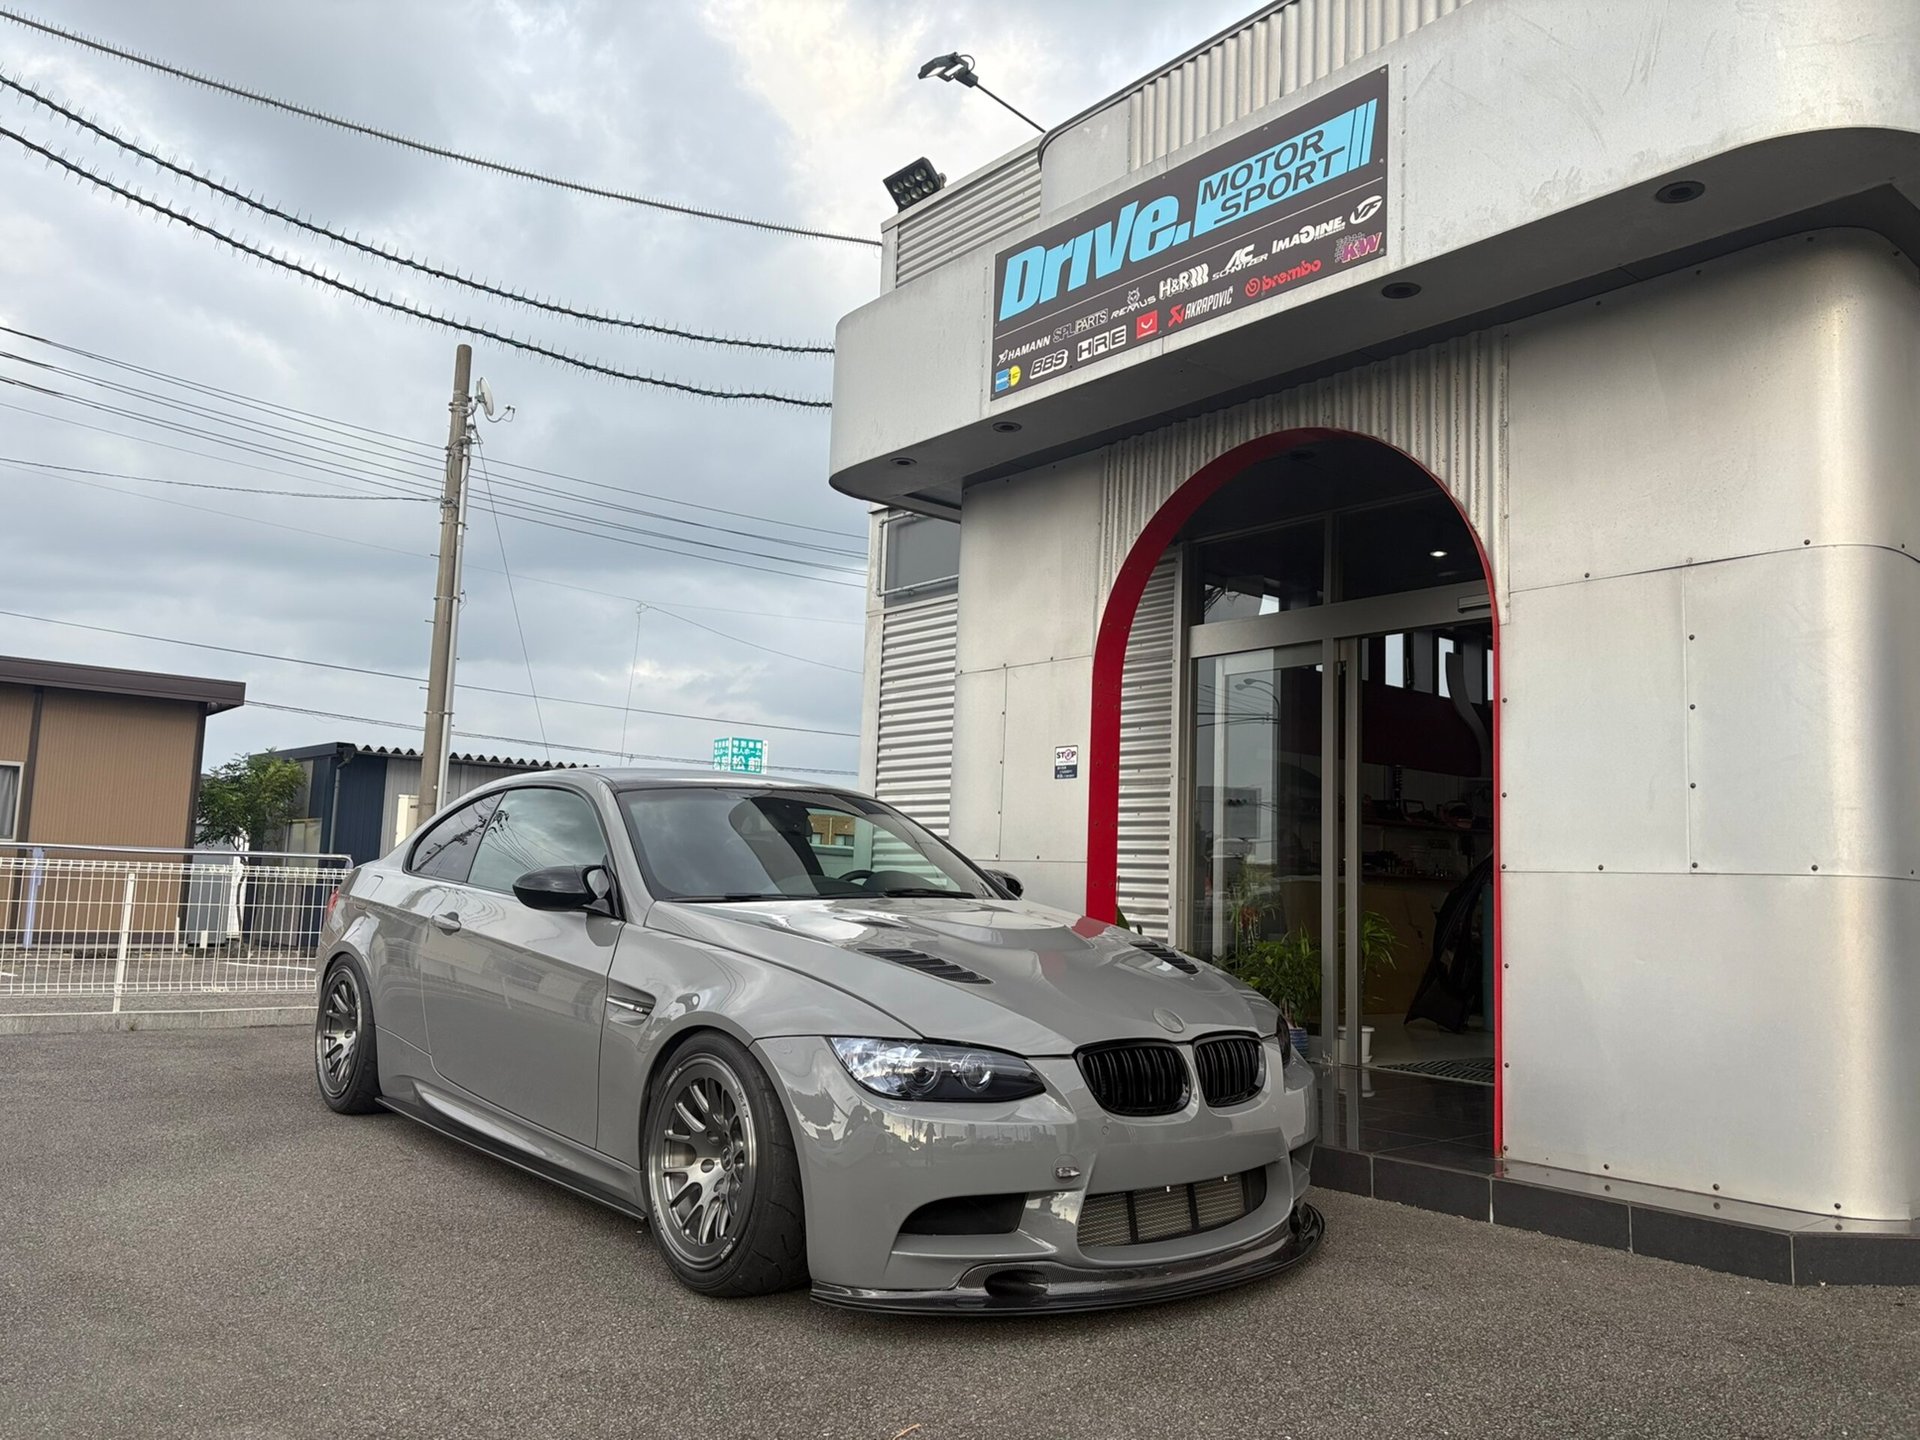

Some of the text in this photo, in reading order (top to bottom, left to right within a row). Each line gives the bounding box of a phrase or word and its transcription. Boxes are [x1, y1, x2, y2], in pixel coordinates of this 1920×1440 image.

[1201, 129, 1325, 205] MOTOR
[1214, 145, 1346, 225] SPORT
[1224, 243, 1256, 272] AC
[1341, 231, 1383, 263] KW
[1212, 253, 1269, 281] SCHNITZER
[1262, 259, 1323, 292] brembo
[1110, 295, 1157, 319] REMUS
[1008, 335, 1051, 360] HAMANN
[1077, 325, 1127, 362] HRE
[1029, 349, 1069, 379] BBS
